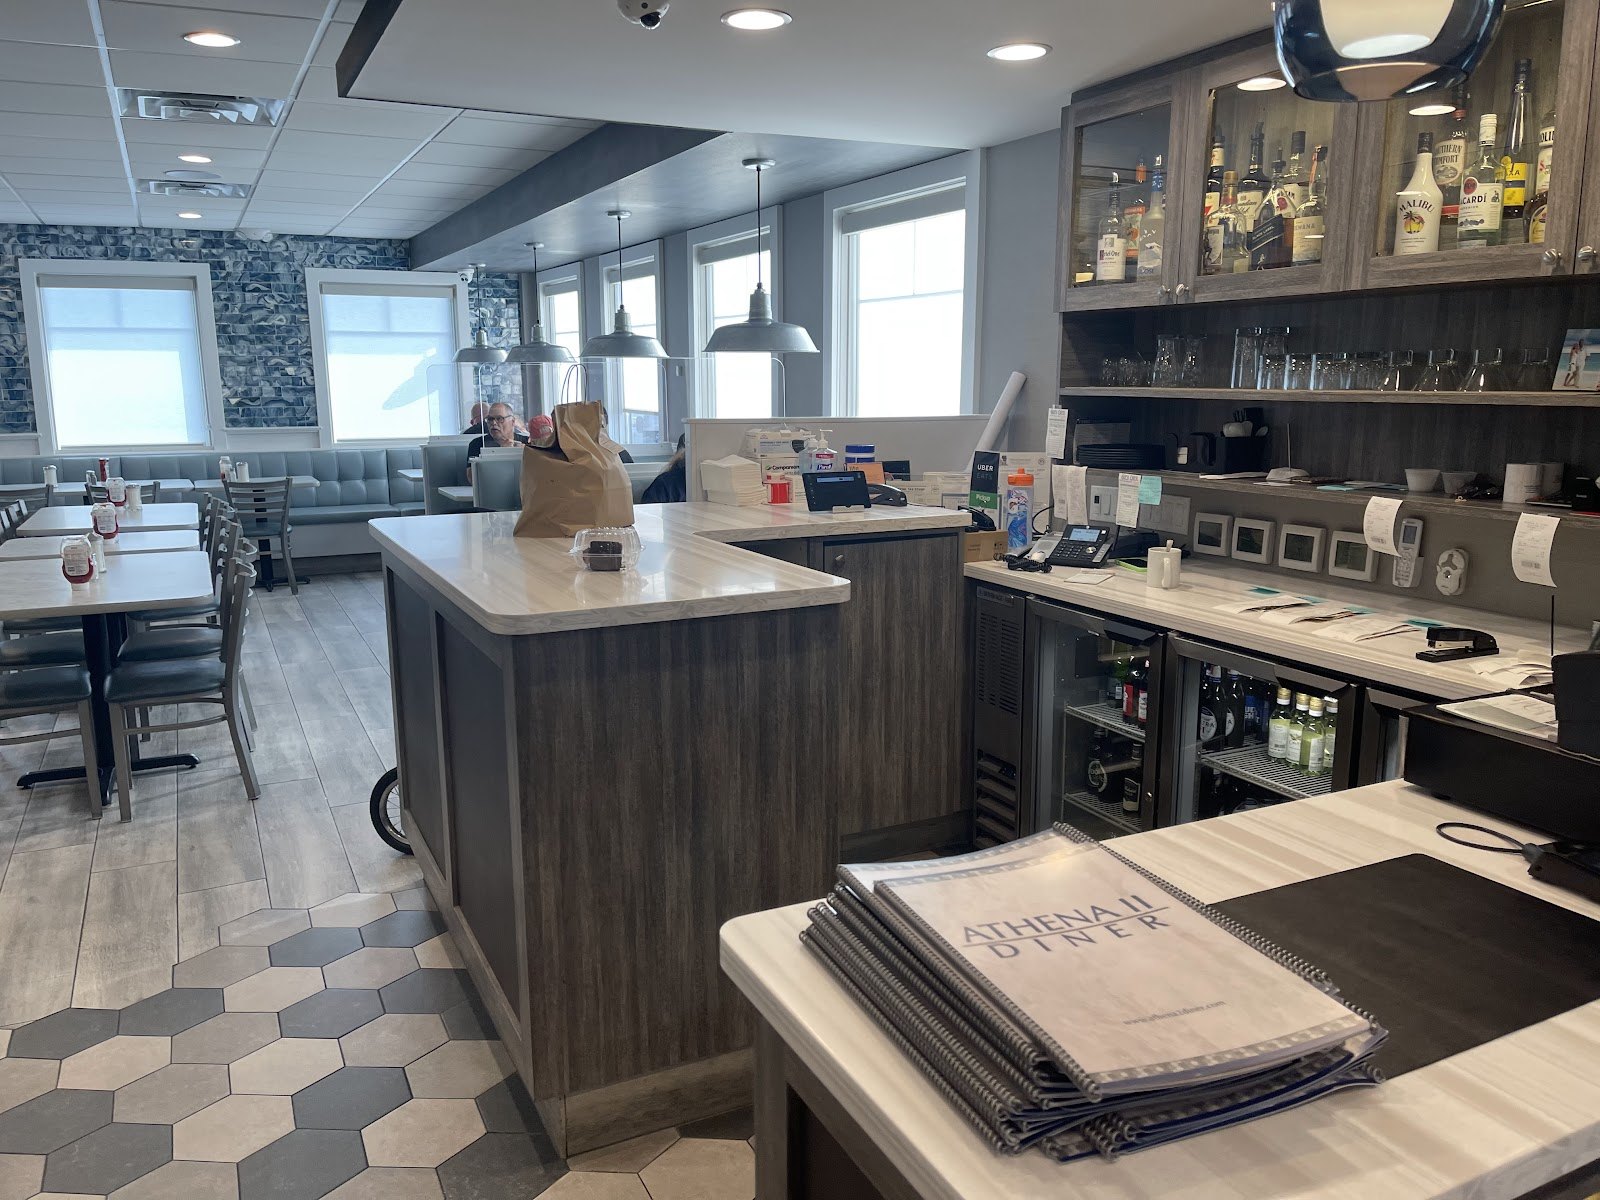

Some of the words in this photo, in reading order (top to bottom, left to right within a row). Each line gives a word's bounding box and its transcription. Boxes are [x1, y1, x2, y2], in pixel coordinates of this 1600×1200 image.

[1399, 199, 1436, 213] MALIBU
[977, 464, 994, 472] UBER
[963, 905, 1122, 943] ATHENA
[1119, 895, 1154, 912] II
[987, 915, 1170, 959] DINER
